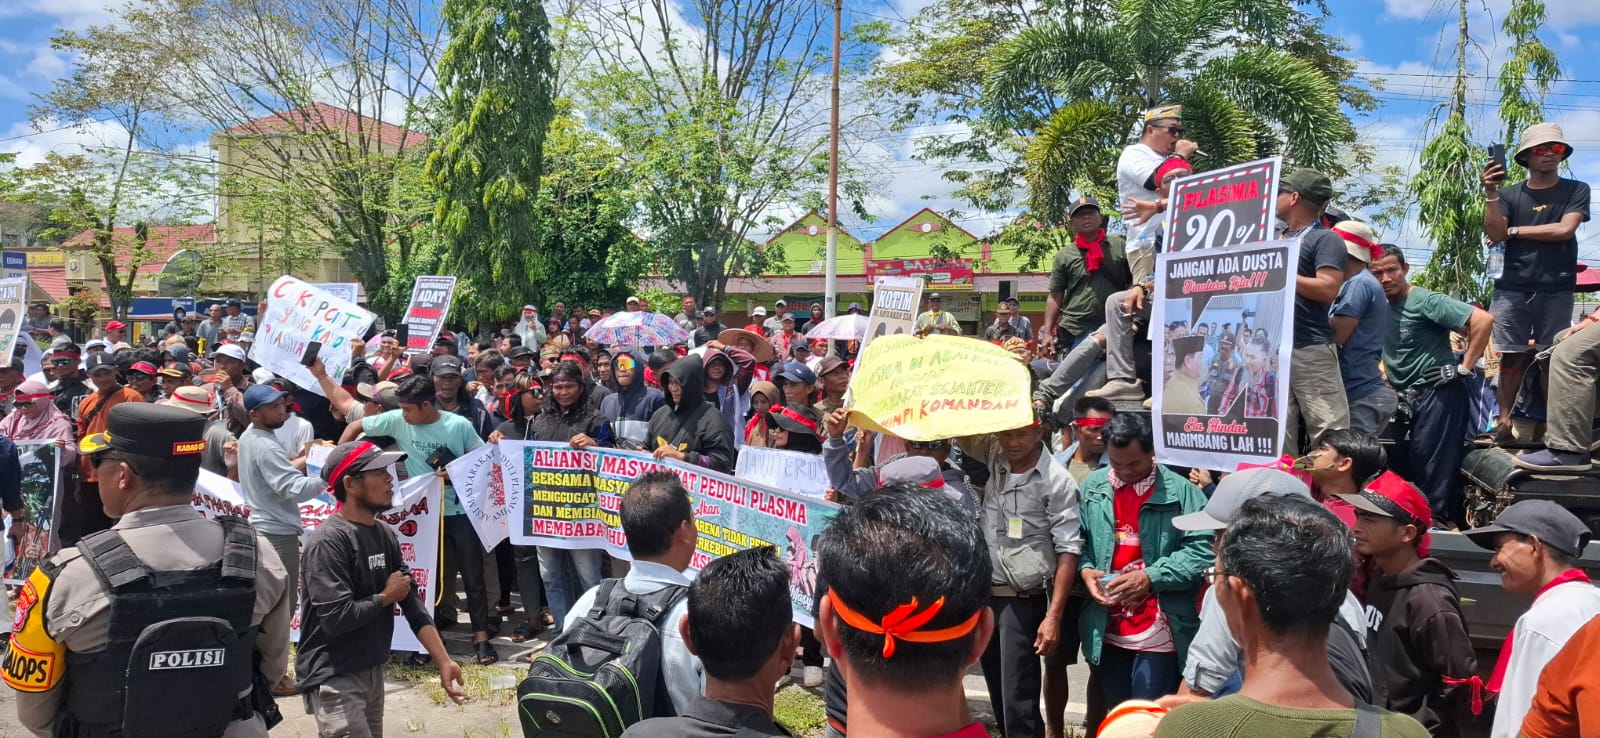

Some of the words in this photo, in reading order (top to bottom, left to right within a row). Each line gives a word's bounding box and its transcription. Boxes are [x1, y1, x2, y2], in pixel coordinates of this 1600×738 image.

[1183, 180, 1258, 211] PLASMA
[1170, 260, 1213, 279] JANGAN
[1217, 257, 1239, 274] ADA
[1243, 252, 1283, 271] DUSTA
[415, 290, 447, 303] ADAT
[878, 290, 914, 311] KOTIM
[919, 398, 1020, 420] KOMANDAN
[1166, 432, 1228, 450] MARIMBANG
[1231, 436, 1254, 452] LAH
[532, 471, 591, 487] BERSAMA
[533, 450, 597, 471] ALIANSI
[700, 476, 747, 506] PEDULI
[750, 490, 807, 525] PLASMA
[533, 490, 596, 504] MENGGUGAT
[695, 500, 720, 516] Akan
[533, 505, 552, 517] DAN
[695, 519, 720, 537] ARENA
[722, 527, 747, 546] TIDAK
[153, 651, 222, 667] POLISI
